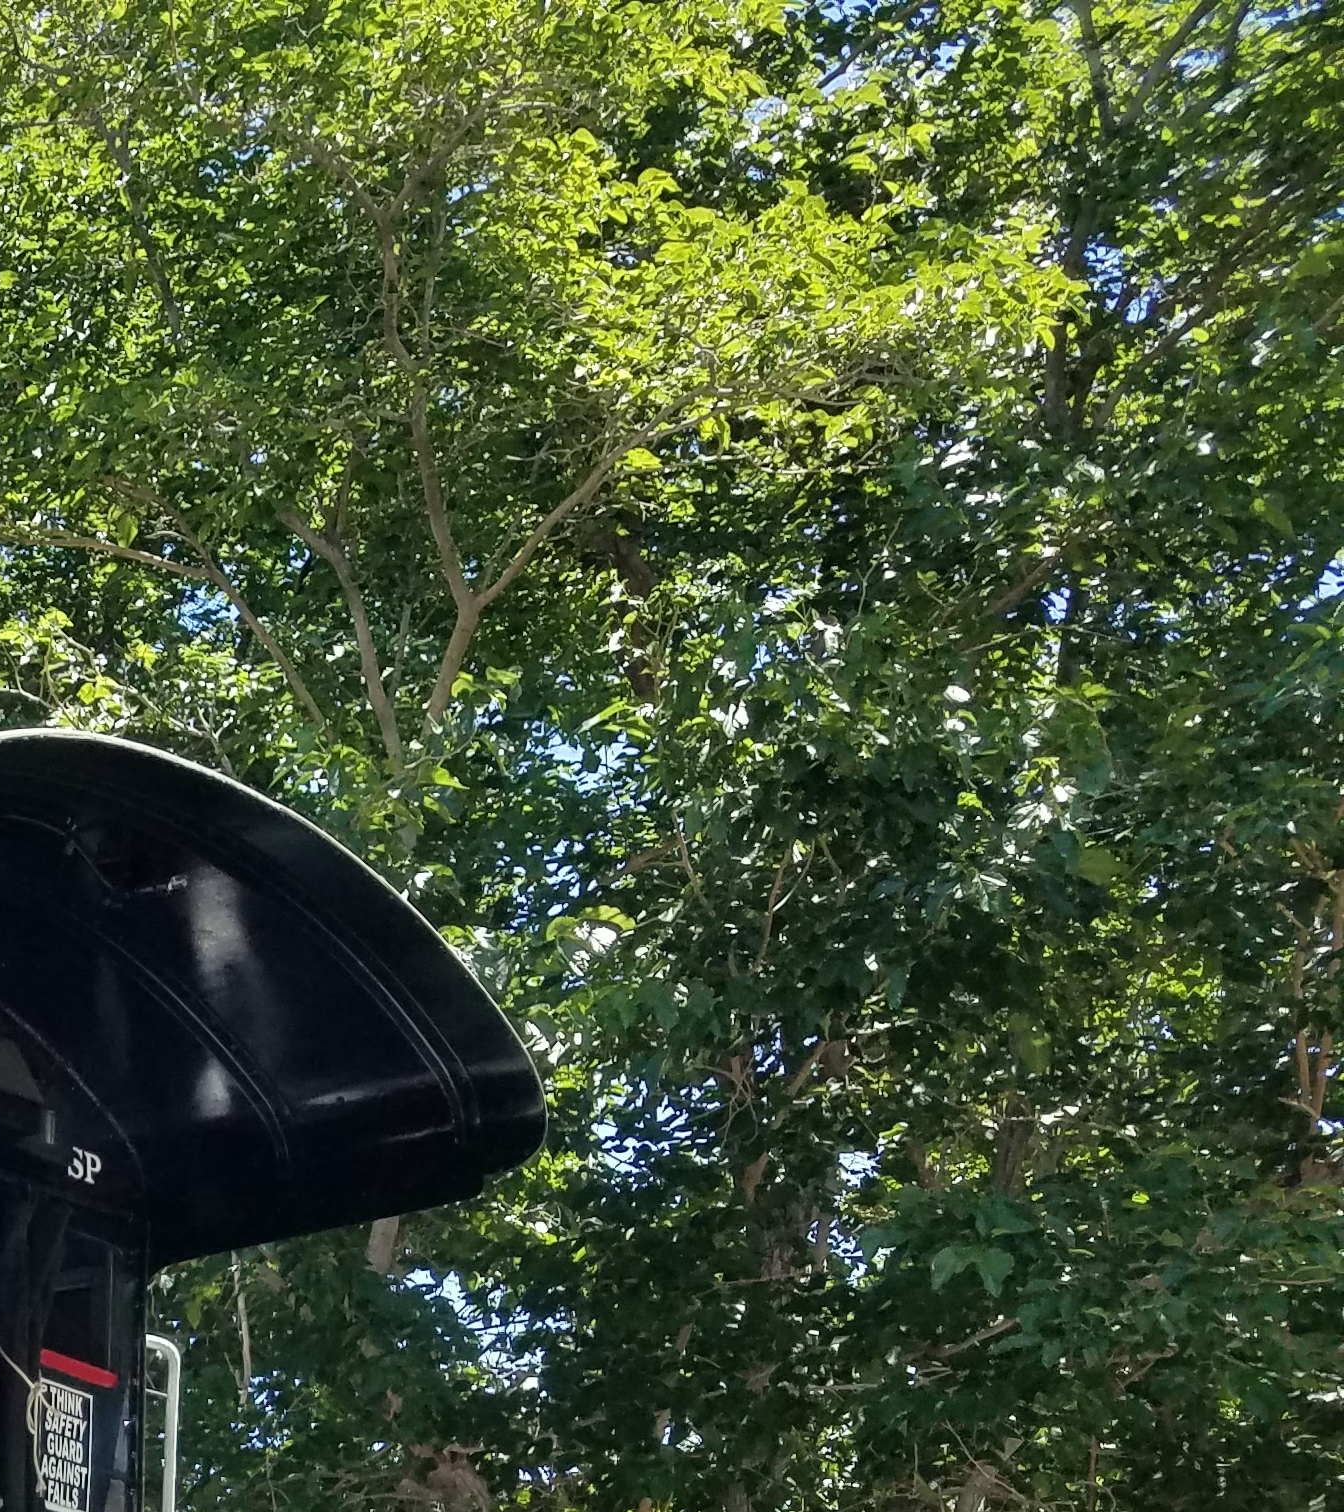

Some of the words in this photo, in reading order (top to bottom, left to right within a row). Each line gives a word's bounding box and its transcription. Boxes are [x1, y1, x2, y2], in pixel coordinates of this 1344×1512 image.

[67, 1146, 102, 1184] SP
[49, 1386, 84, 1418] THINK
[44, 1408, 87, 1441] SAFETY
[46, 1432, 84, 1464] GUARD
[40, 1454, 88, 1489] AGAINST
[47, 1479, 79, 1510] FALLS
